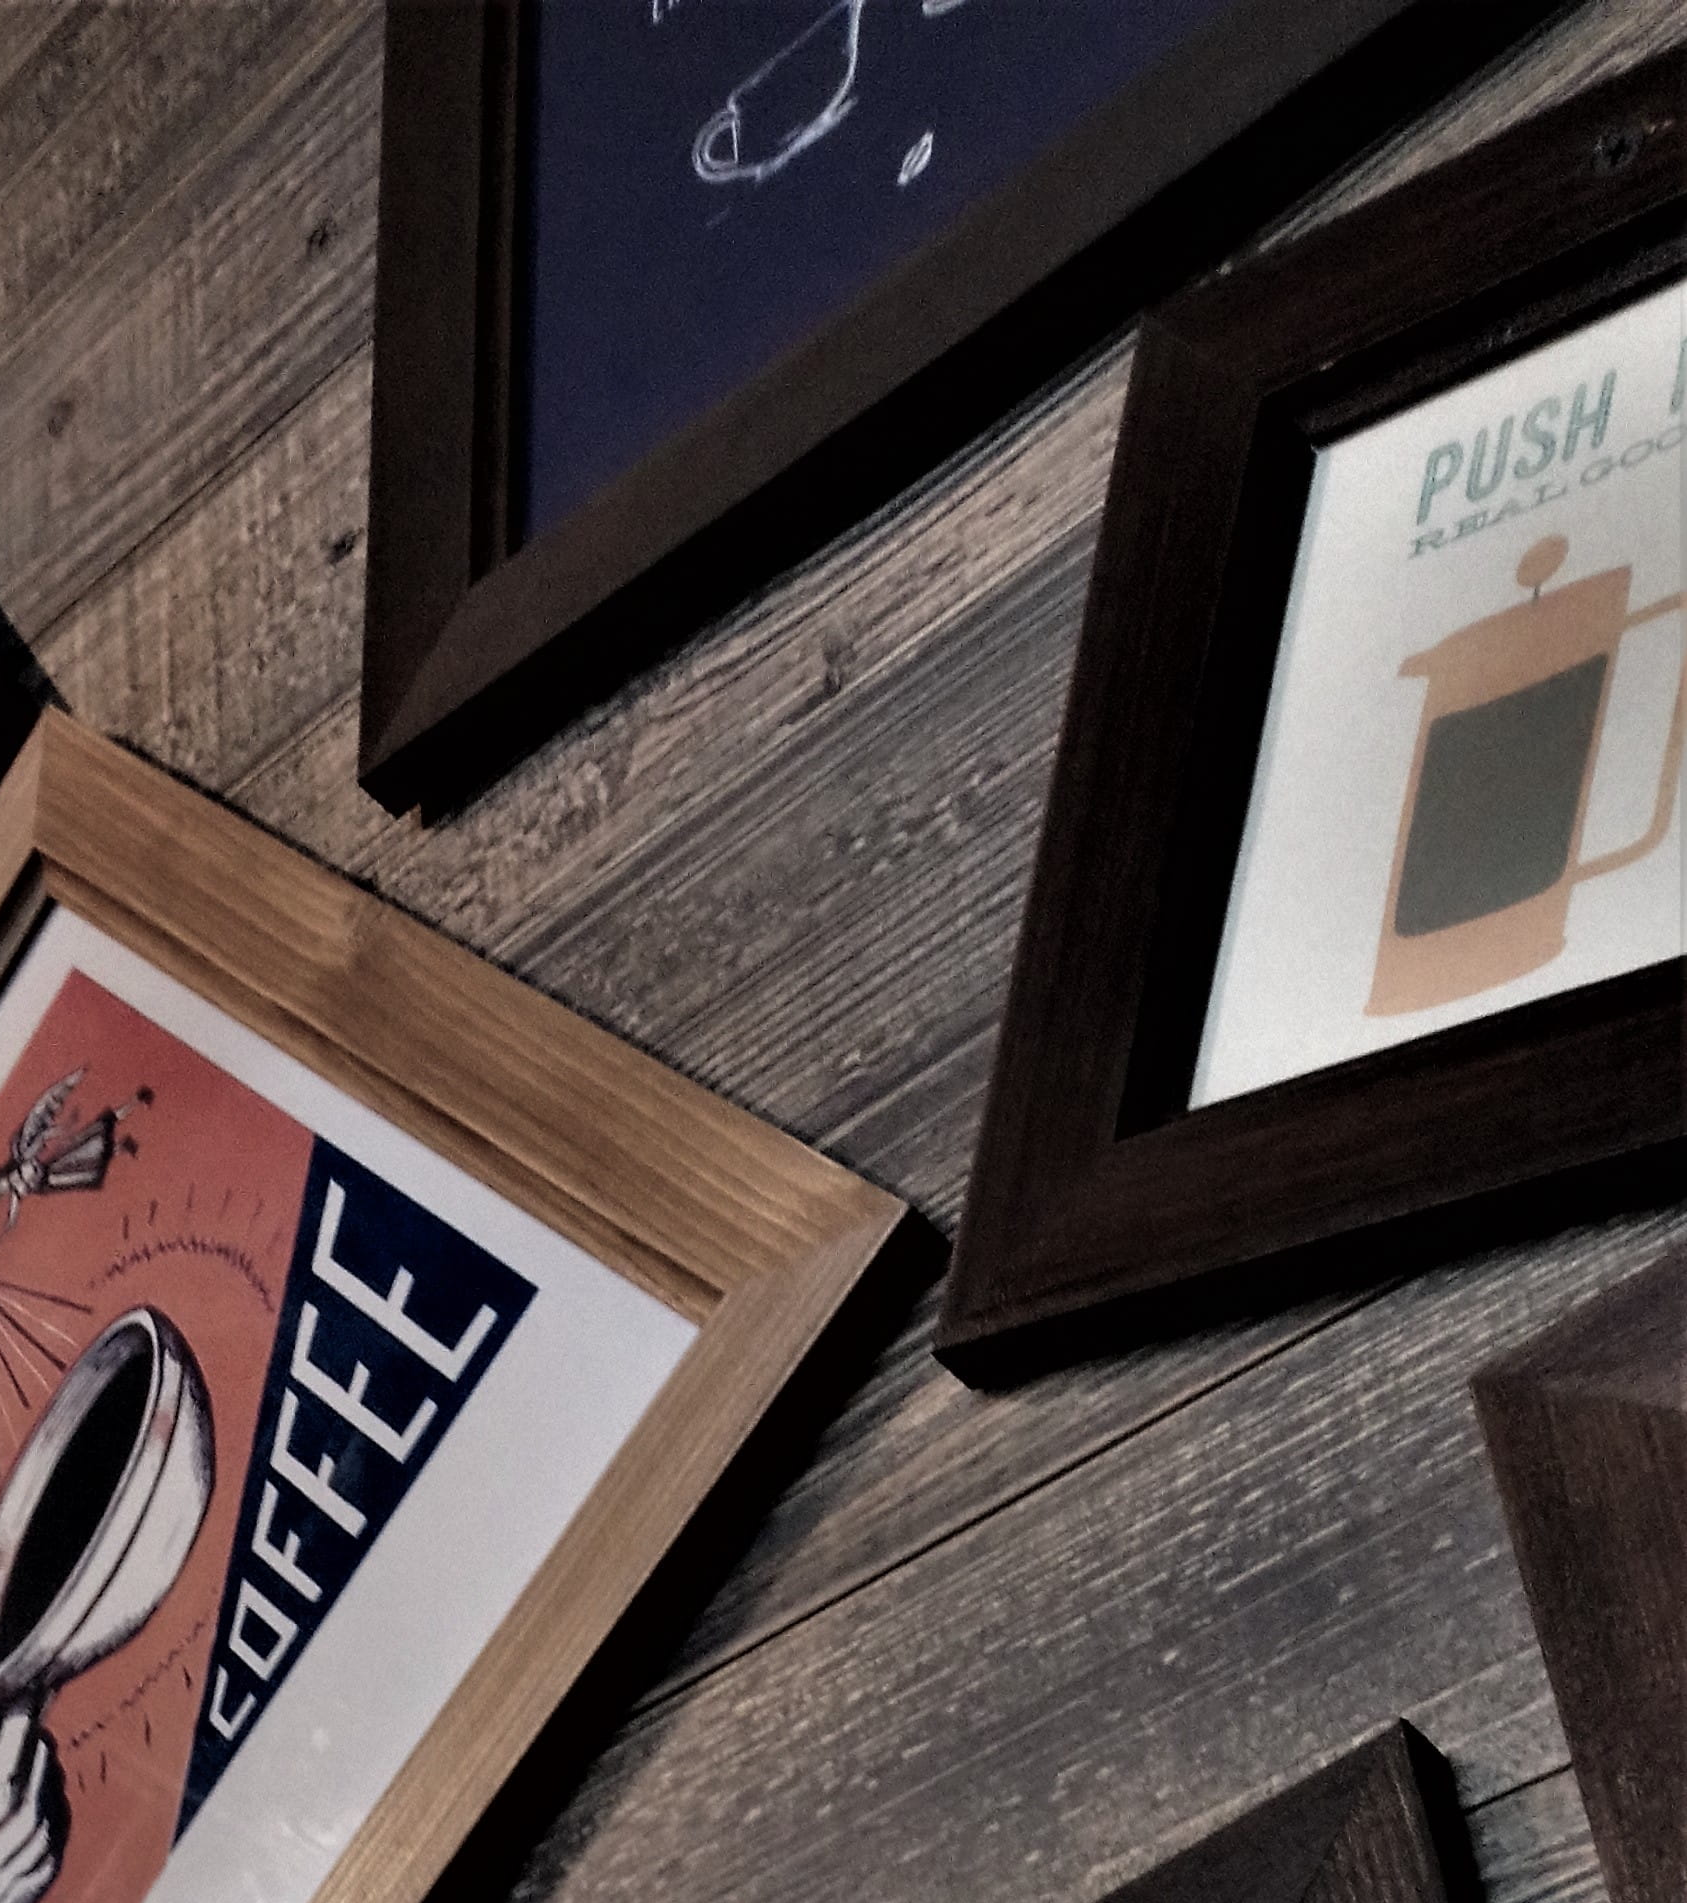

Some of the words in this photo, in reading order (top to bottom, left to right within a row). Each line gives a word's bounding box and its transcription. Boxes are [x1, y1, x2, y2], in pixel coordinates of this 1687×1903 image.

[1409, 482, 1568, 560] REAL
[1416, 368, 1618, 526] PUSH
[208, 1176, 500, 1745] COFFEE
